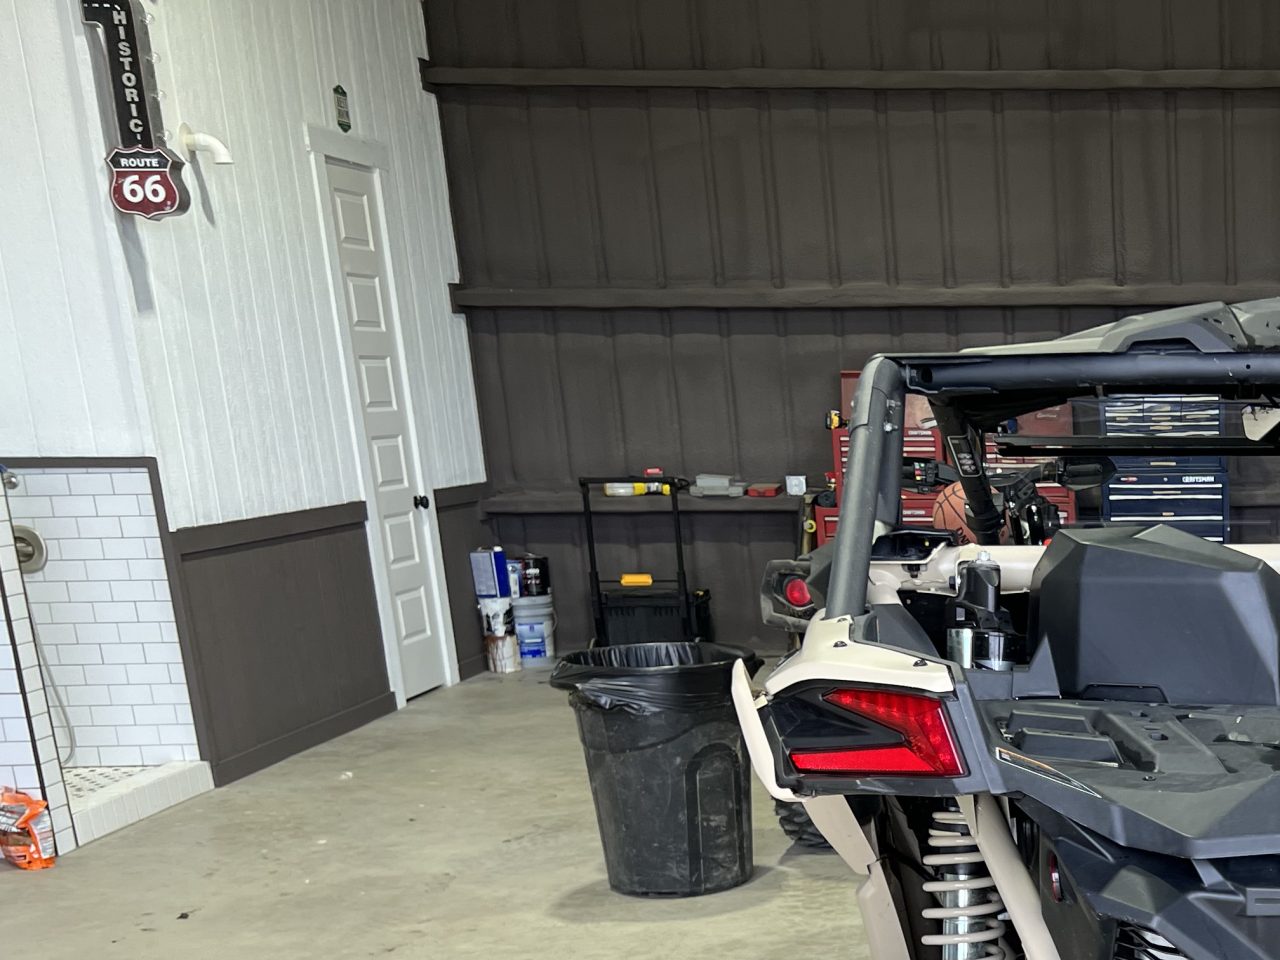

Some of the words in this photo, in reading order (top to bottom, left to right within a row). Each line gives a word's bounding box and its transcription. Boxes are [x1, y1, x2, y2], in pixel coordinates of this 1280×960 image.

[112, 11, 144, 133] HISTORIC
[120, 157, 159, 168] ROUTE
[122, 174, 166, 203] 66
